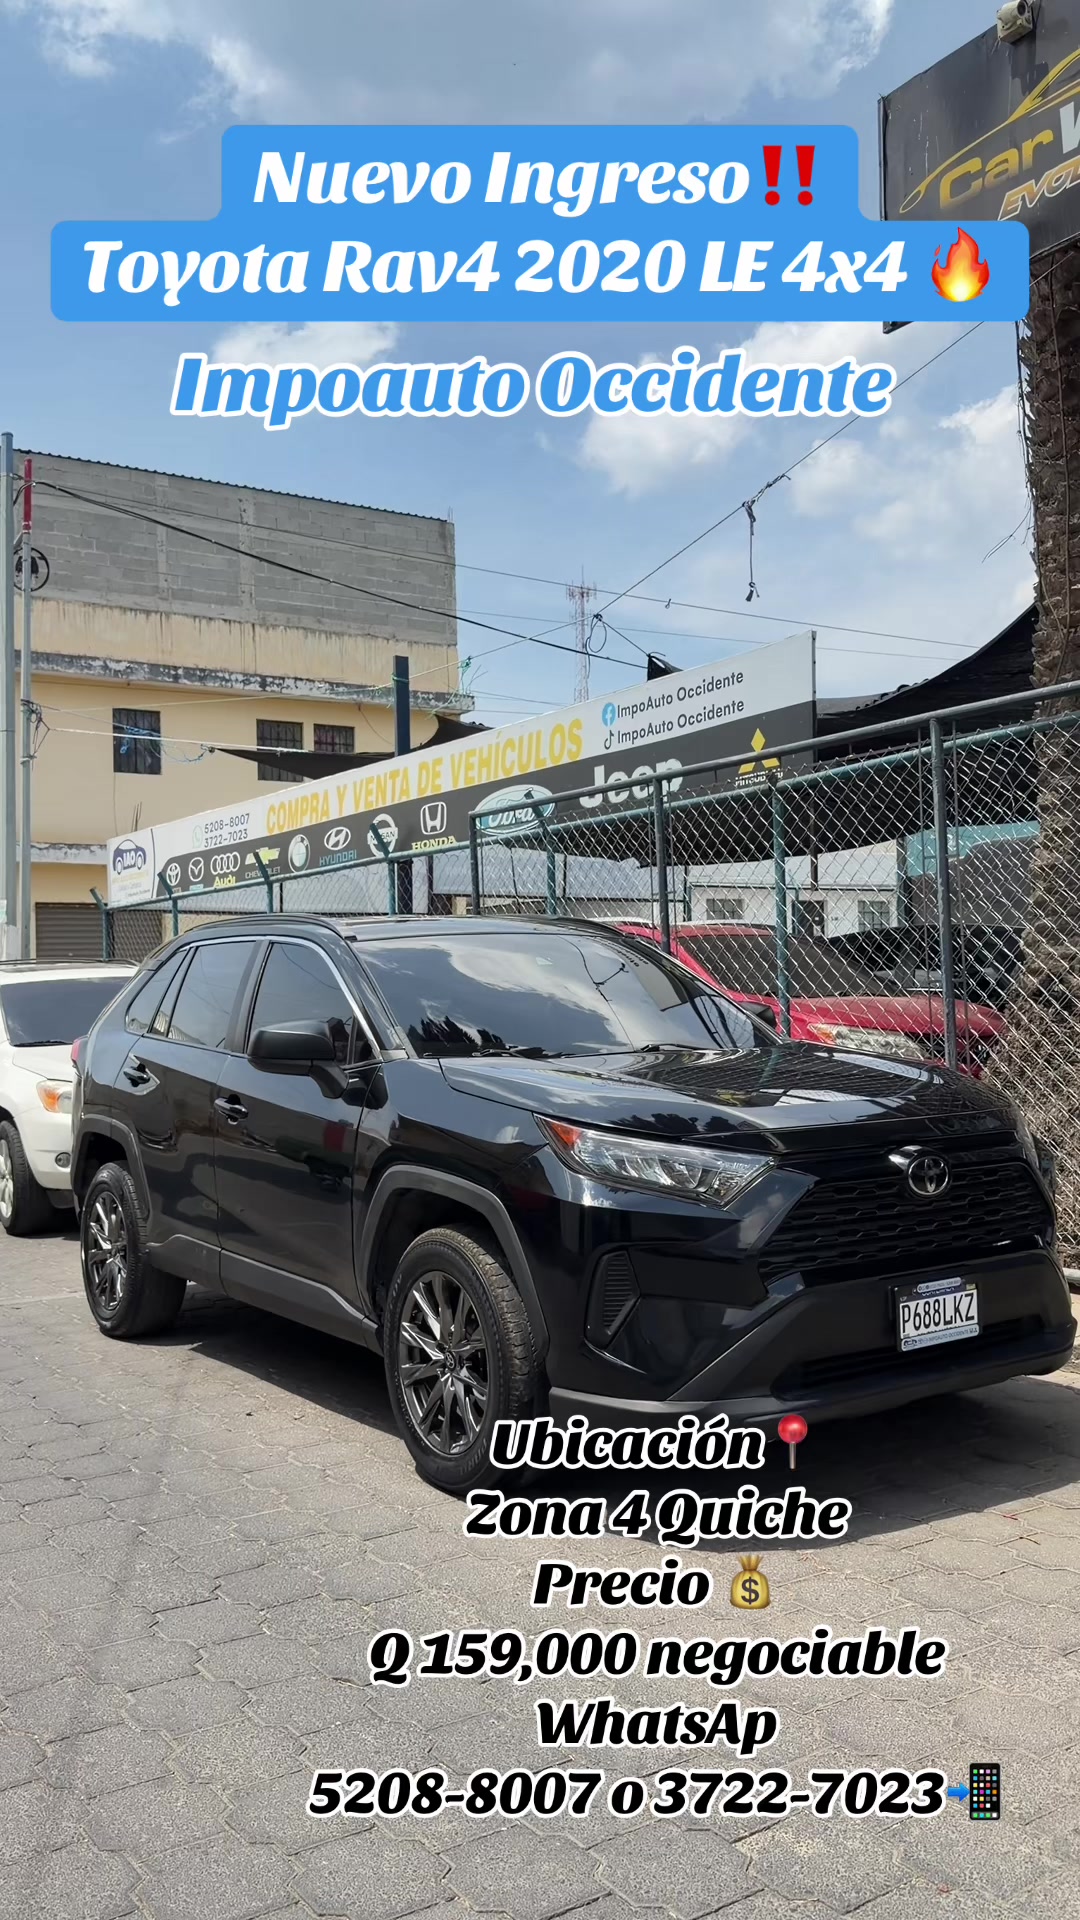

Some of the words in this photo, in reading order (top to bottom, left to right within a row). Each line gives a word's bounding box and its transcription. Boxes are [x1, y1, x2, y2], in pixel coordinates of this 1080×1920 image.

[617, 693, 673, 719] ImpoAuto
[676, 671, 744, 701] Occidente
[617, 718, 674, 744] ImpoAuto
[677, 699, 745, 729] Occidente
[266, 790, 331, 836] COMPRA
[336, 784, 349, 816] Y
[353, 767, 411, 813] VENTA
[417, 757, 444, 798] DE
[450, 718, 584, 790] VEHÍCULOS
[579, 758, 683, 809] Jeep
[204, 813, 250, 834] 5208-8007
[204, 829, 248, 848] 3722-7023
[319, 849, 357, 867] HYUNDAI
[412, 836, 457, 851] HONDA
[213, 874, 236, 888] Audi
[901, 1292, 975, 1334] P688LKZ
